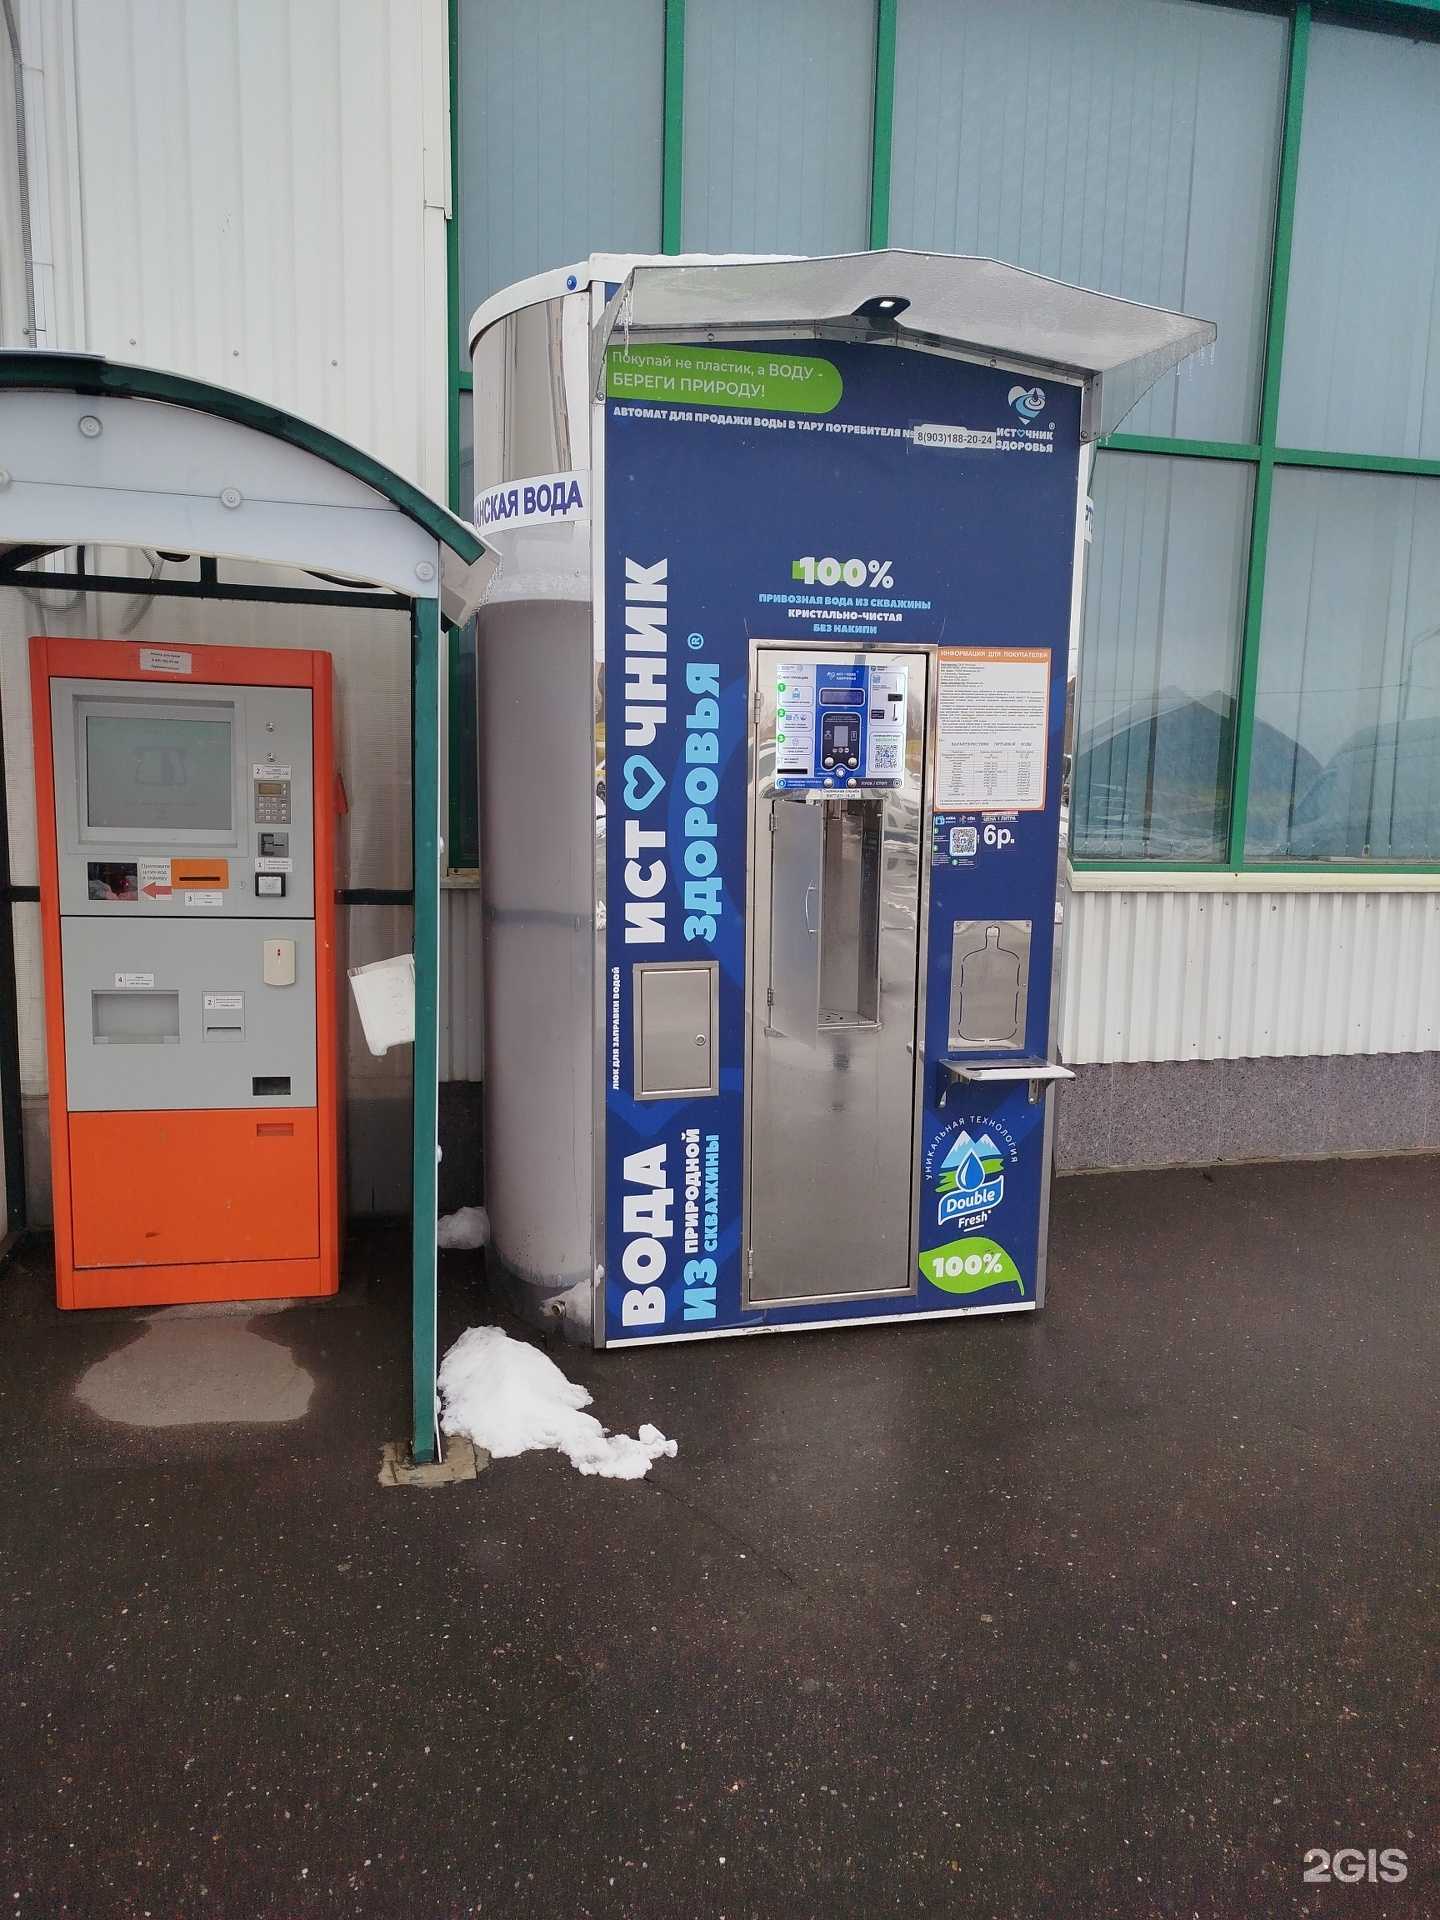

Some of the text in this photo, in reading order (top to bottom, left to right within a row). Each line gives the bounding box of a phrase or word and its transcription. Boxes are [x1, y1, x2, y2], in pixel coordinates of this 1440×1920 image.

[612, 351, 672, 369] Покупай
[675, 358, 692, 369] не
[696, 360, 754, 376] пластик,
[758, 367, 765, 375] а
[769, 363, 814, 380] ВОДУ
[613, 373, 766, 398] БЕРЕГИ ПРИРОДУ!
[613, 406, 668, 419] АВТОМАТ
[669, 410, 693, 421] ДЛЯ
[695, 412, 752, 426] ПРОДАЖИ
[754, 417, 787, 429] ВОДЫ
[789, 420, 796, 429] В
[798, 421, 825, 432] ТАРУ
[826, 423, 900, 438] ПОТРЕБИТЕЛЯ
[917, 431, 993, 445] 8(903)188-20-24
[996, 439, 1053, 453] ЗДОРОВЬЯ
[523, 480, 584, 516] ВОДА
[800, 557, 895, 589] 100%
[758, 593, 931, 609] ПРИВОЗНАЯ ВОДА ИЗ СКВАЖИНЫ
[788, 609, 903, 622] КРИСТАЛЬНО-ЧИСТАЯ
[813, 623, 877, 634] БЕЗ НАКИПИ
[683, 662, 723, 943] ЗДОРОВЬЯ
[611, 966, 621, 1091] ЛЮК ДЛЯ ЗАПРАВКИ ВОДОЙ
[926, 1115, 1019, 1180] УНИКАЛЬНАЯ ТЕХНОЛОГИЯ
[703, 1134, 720, 1252] СКВАЖИНЫ
[946, 1189, 996, 1213] Double
[681, 1128, 718, 1321] ИЗ ПРИРОДНОЙ
[958, 1211, 988, 1229] Fresh
[622, 1143, 674, 1327] ВОДА
[932, 1252, 1004, 1278] 100%
